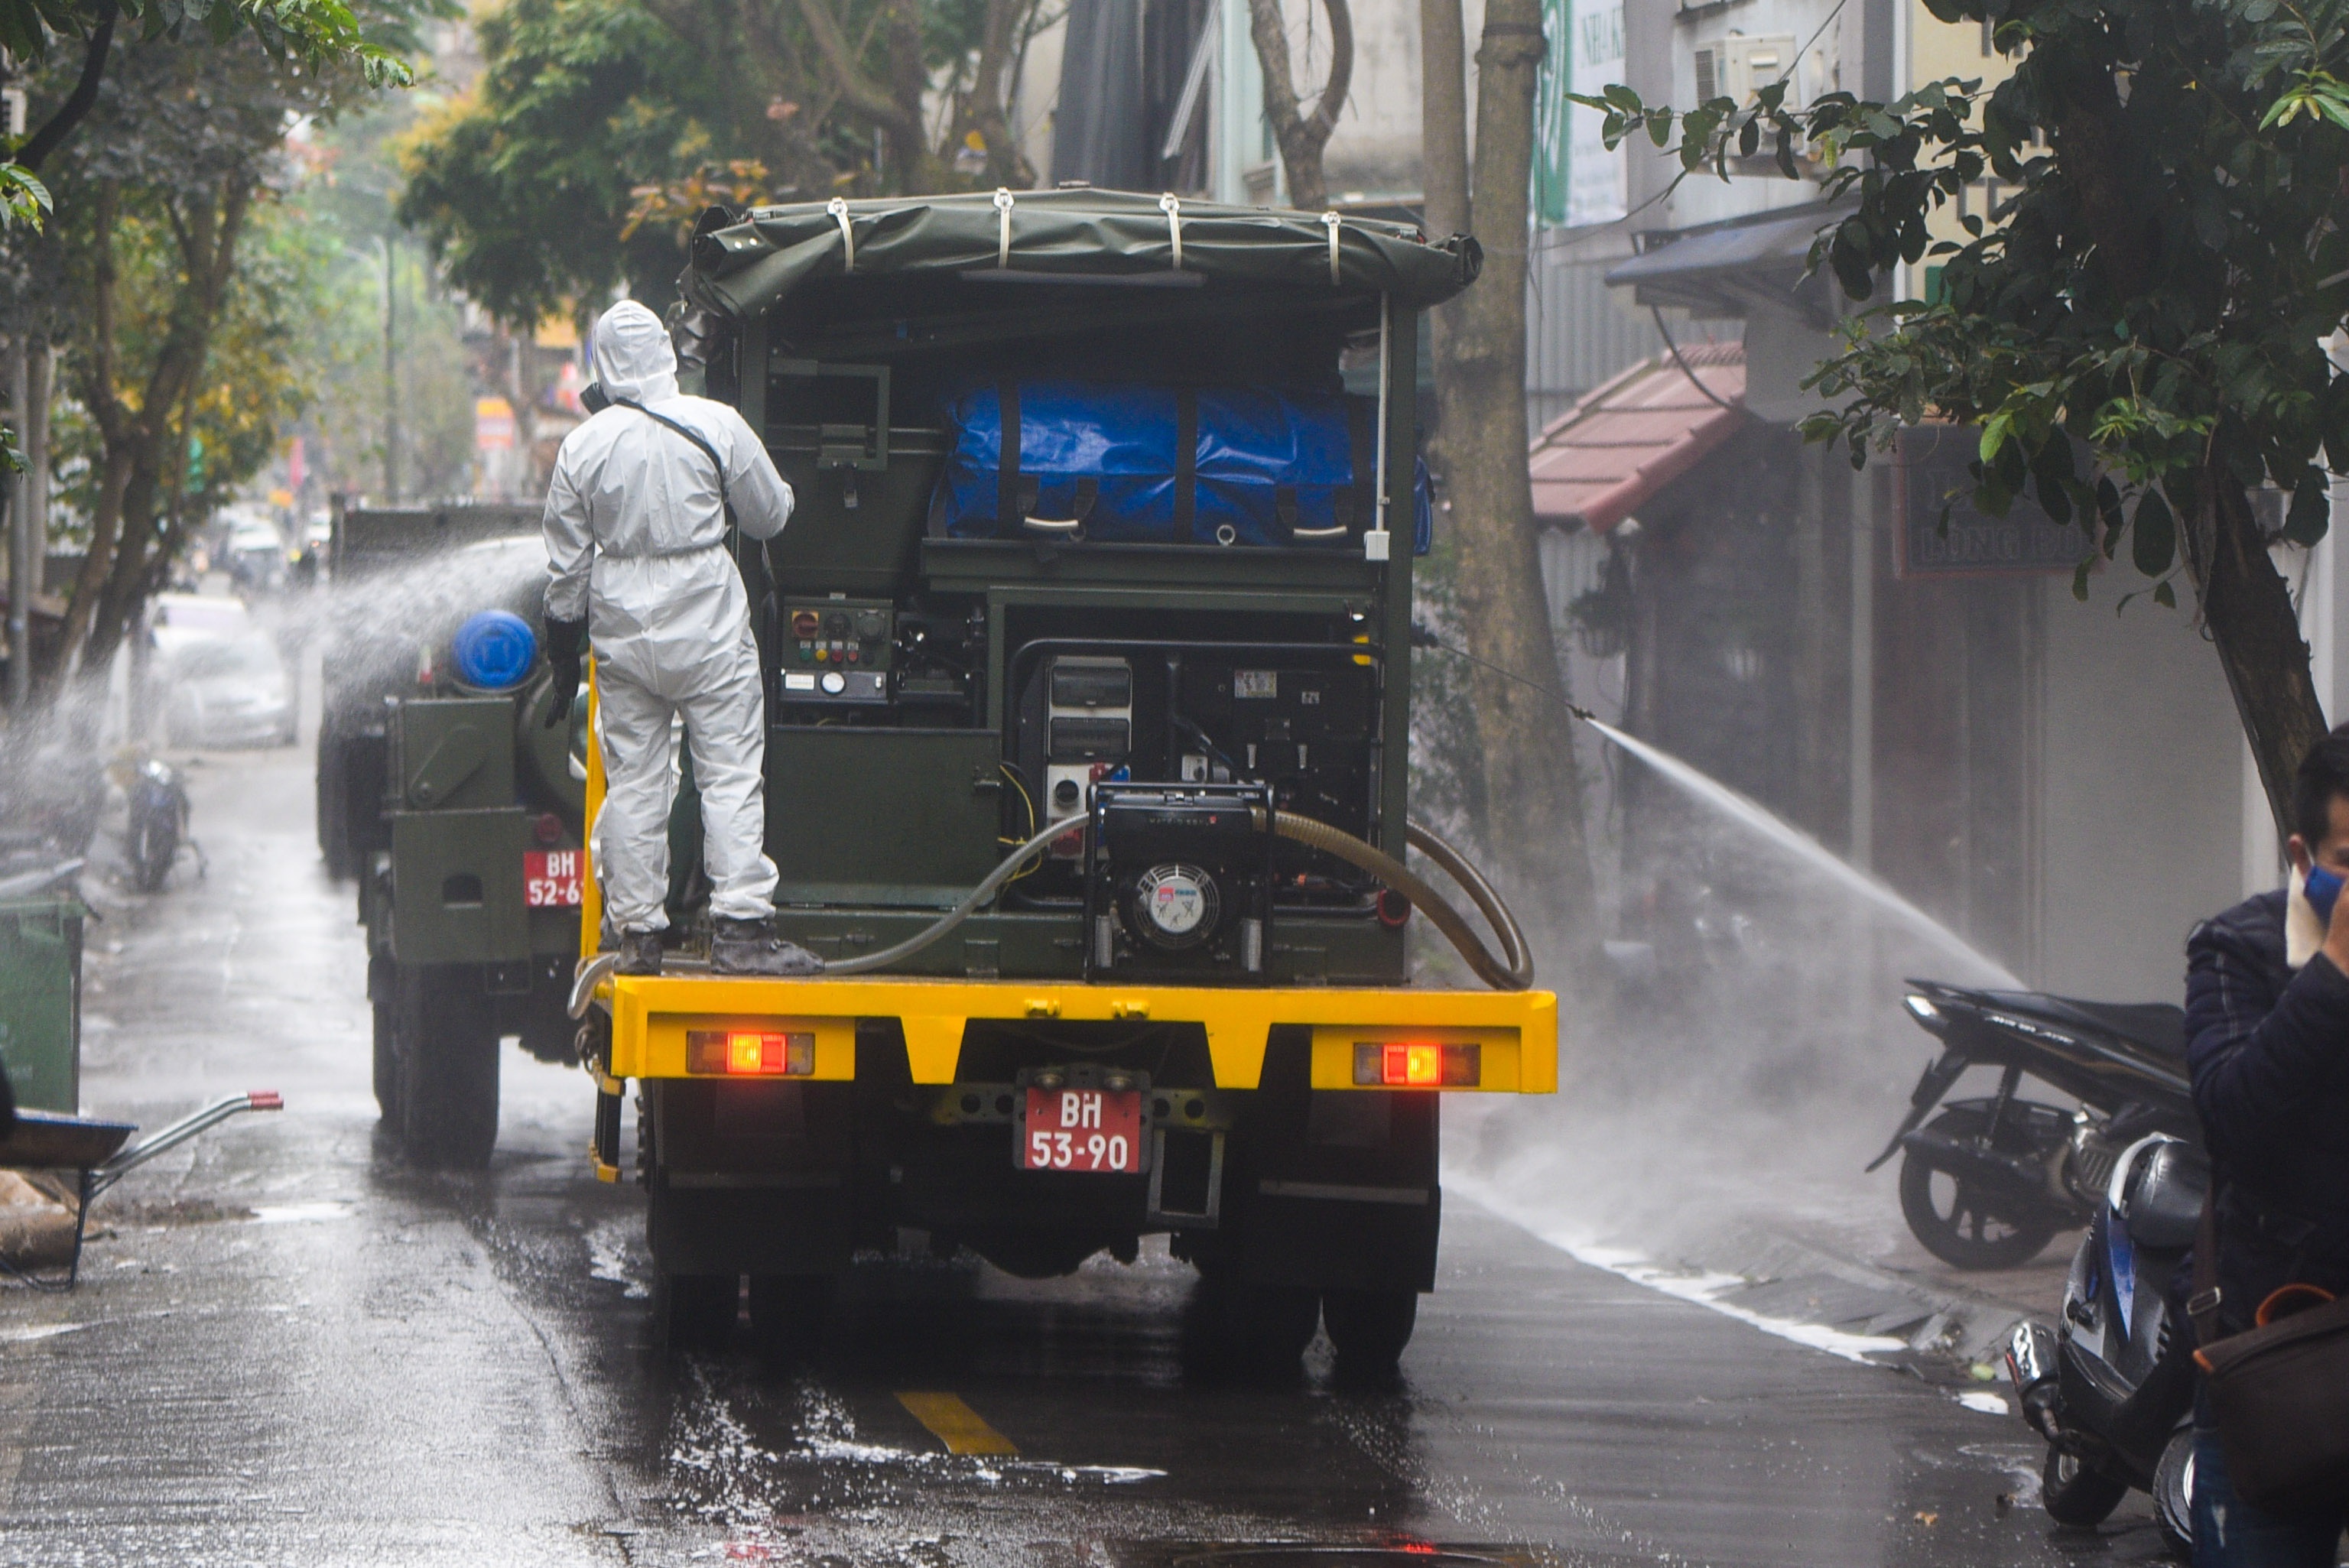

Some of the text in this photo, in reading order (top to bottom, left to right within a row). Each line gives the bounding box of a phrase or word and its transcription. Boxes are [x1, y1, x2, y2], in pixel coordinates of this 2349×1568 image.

[547, 850, 575, 878] BH
[528, 878, 584, 906] 52-6
[1061, 1092, 1102, 1128] BH
[1032, 1131, 1129, 1170] 53-90
